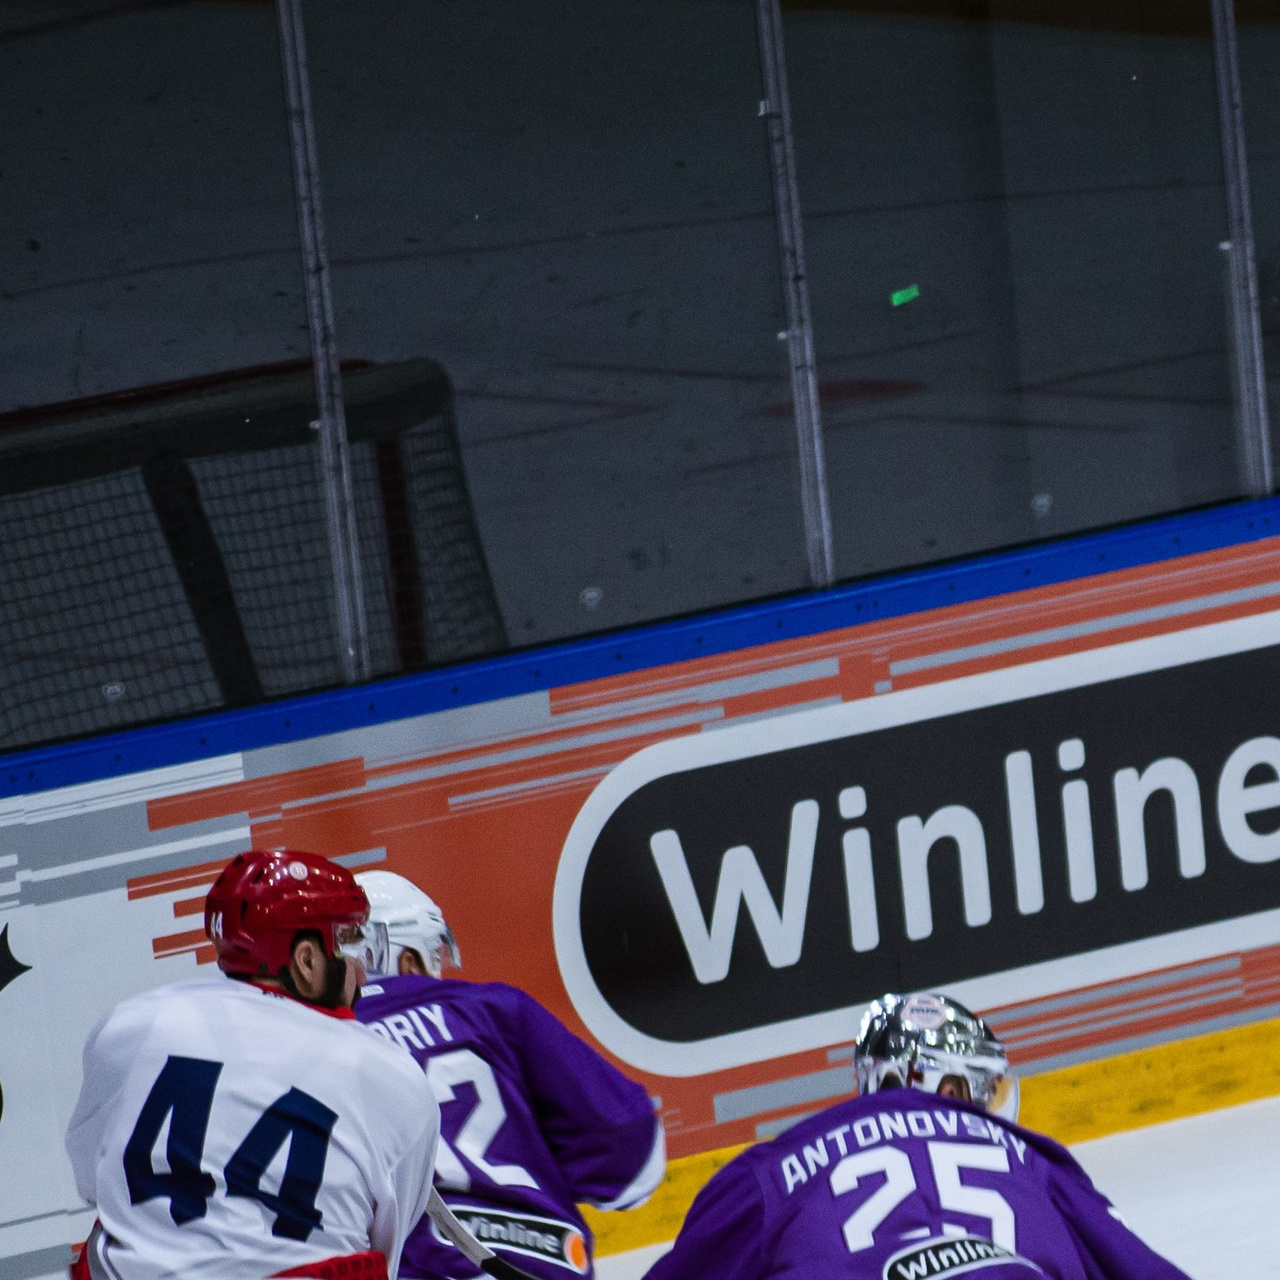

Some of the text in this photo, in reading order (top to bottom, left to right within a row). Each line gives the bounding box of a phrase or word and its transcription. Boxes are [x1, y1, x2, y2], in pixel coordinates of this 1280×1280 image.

[123, 1055, 338, 1242] 44
[781, 1109, 1028, 1193] ANTONOVSKY
[829, 1141, 1016, 1253] 25
